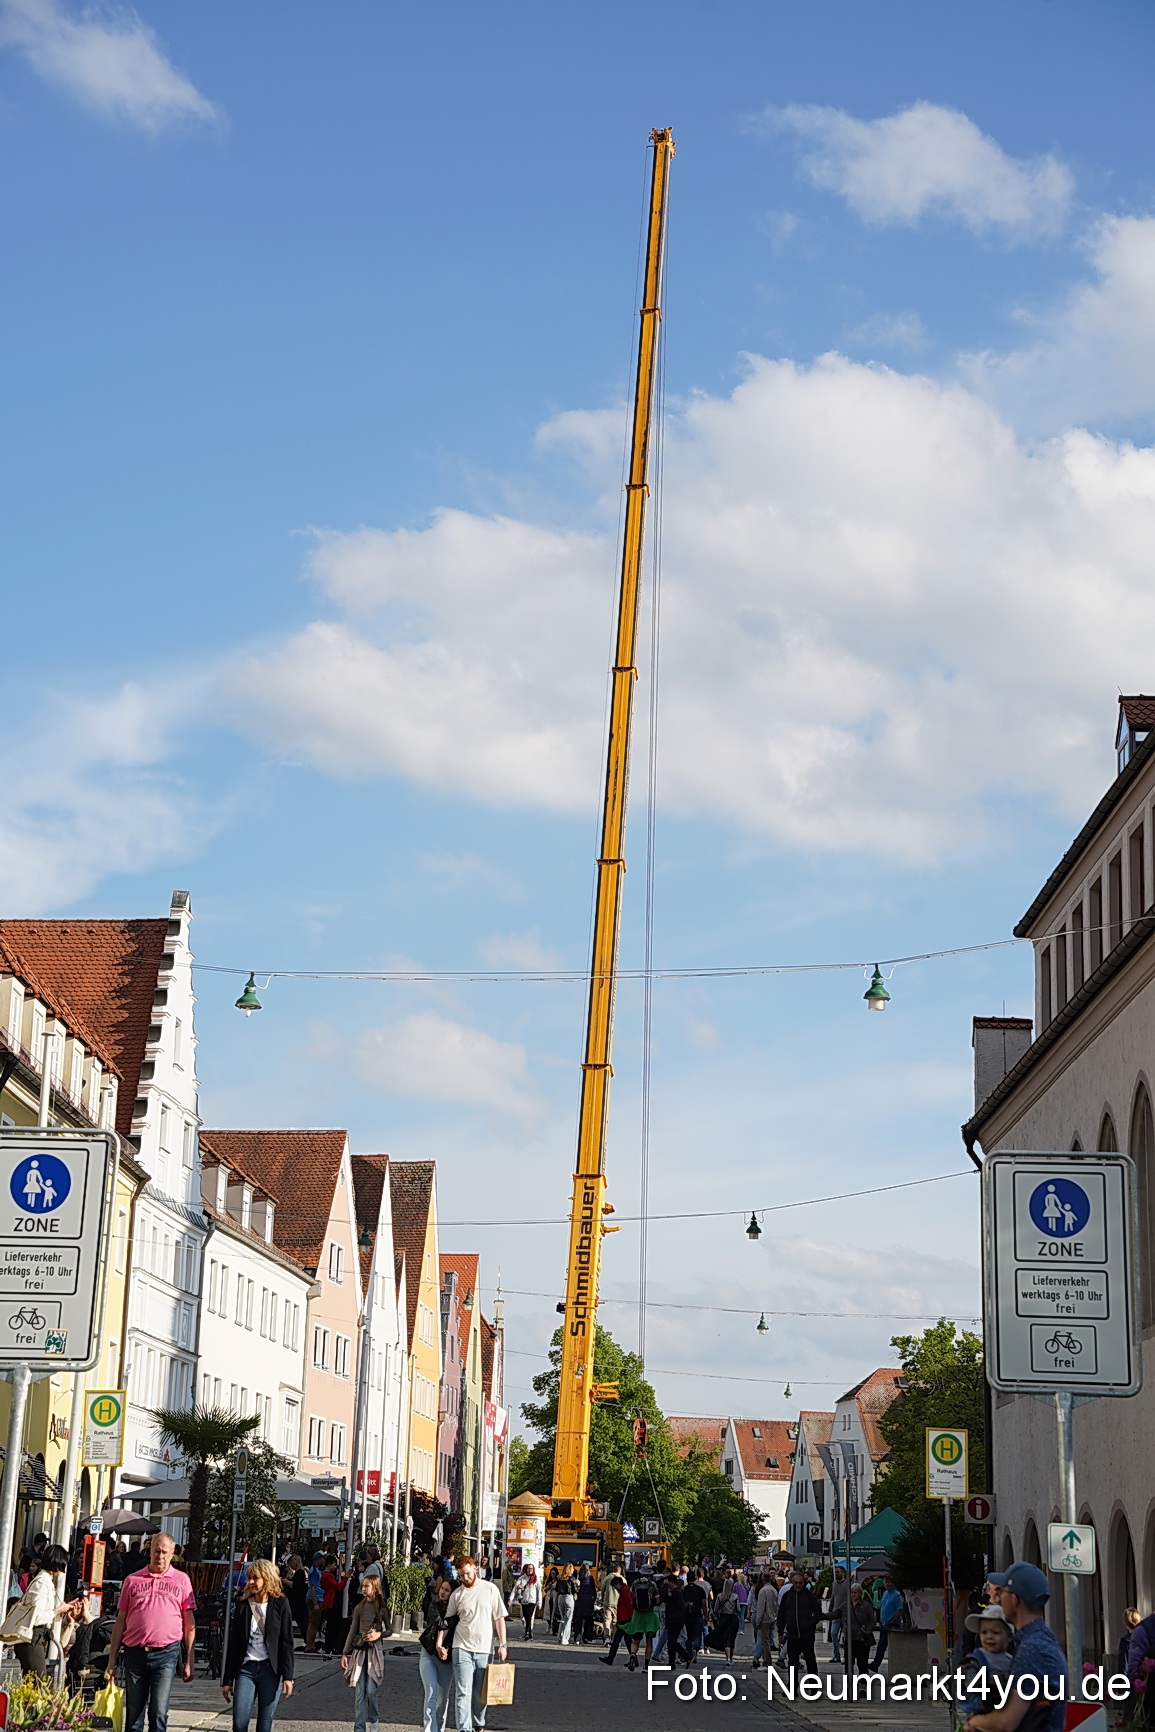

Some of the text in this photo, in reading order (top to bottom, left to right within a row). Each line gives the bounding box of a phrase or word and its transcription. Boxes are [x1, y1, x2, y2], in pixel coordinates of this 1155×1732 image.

[13, 1217, 60, 1232] ZONE
[1037, 1241, 1084, 1257] ZONE
[4, 1251, 62, 1262] Lieferverkehr
[570, 1182, 595, 1336] Schmidbauer
[0, 1265, 73, 1278] erktags 6-10 Uhr
[24, 1279, 44, 1289] frei
[1032, 1275, 1091, 1287] Lieferverkehr
[1021, 1290, 1103, 1302] werktags 6-10 Uhr
[1055, 1303, 1076, 1314] frei
[15, 1333, 36, 1344] frei
[1054, 1357, 1075, 1368] frei
[98, 1402, 112, 1420] H
[940, 1440, 953, 1458] H
[847, 1462, 857, 1502] SCHMID
[130, 1581, 153, 1597] CAMP
[158, 1581, 180, 1598] DAVID
